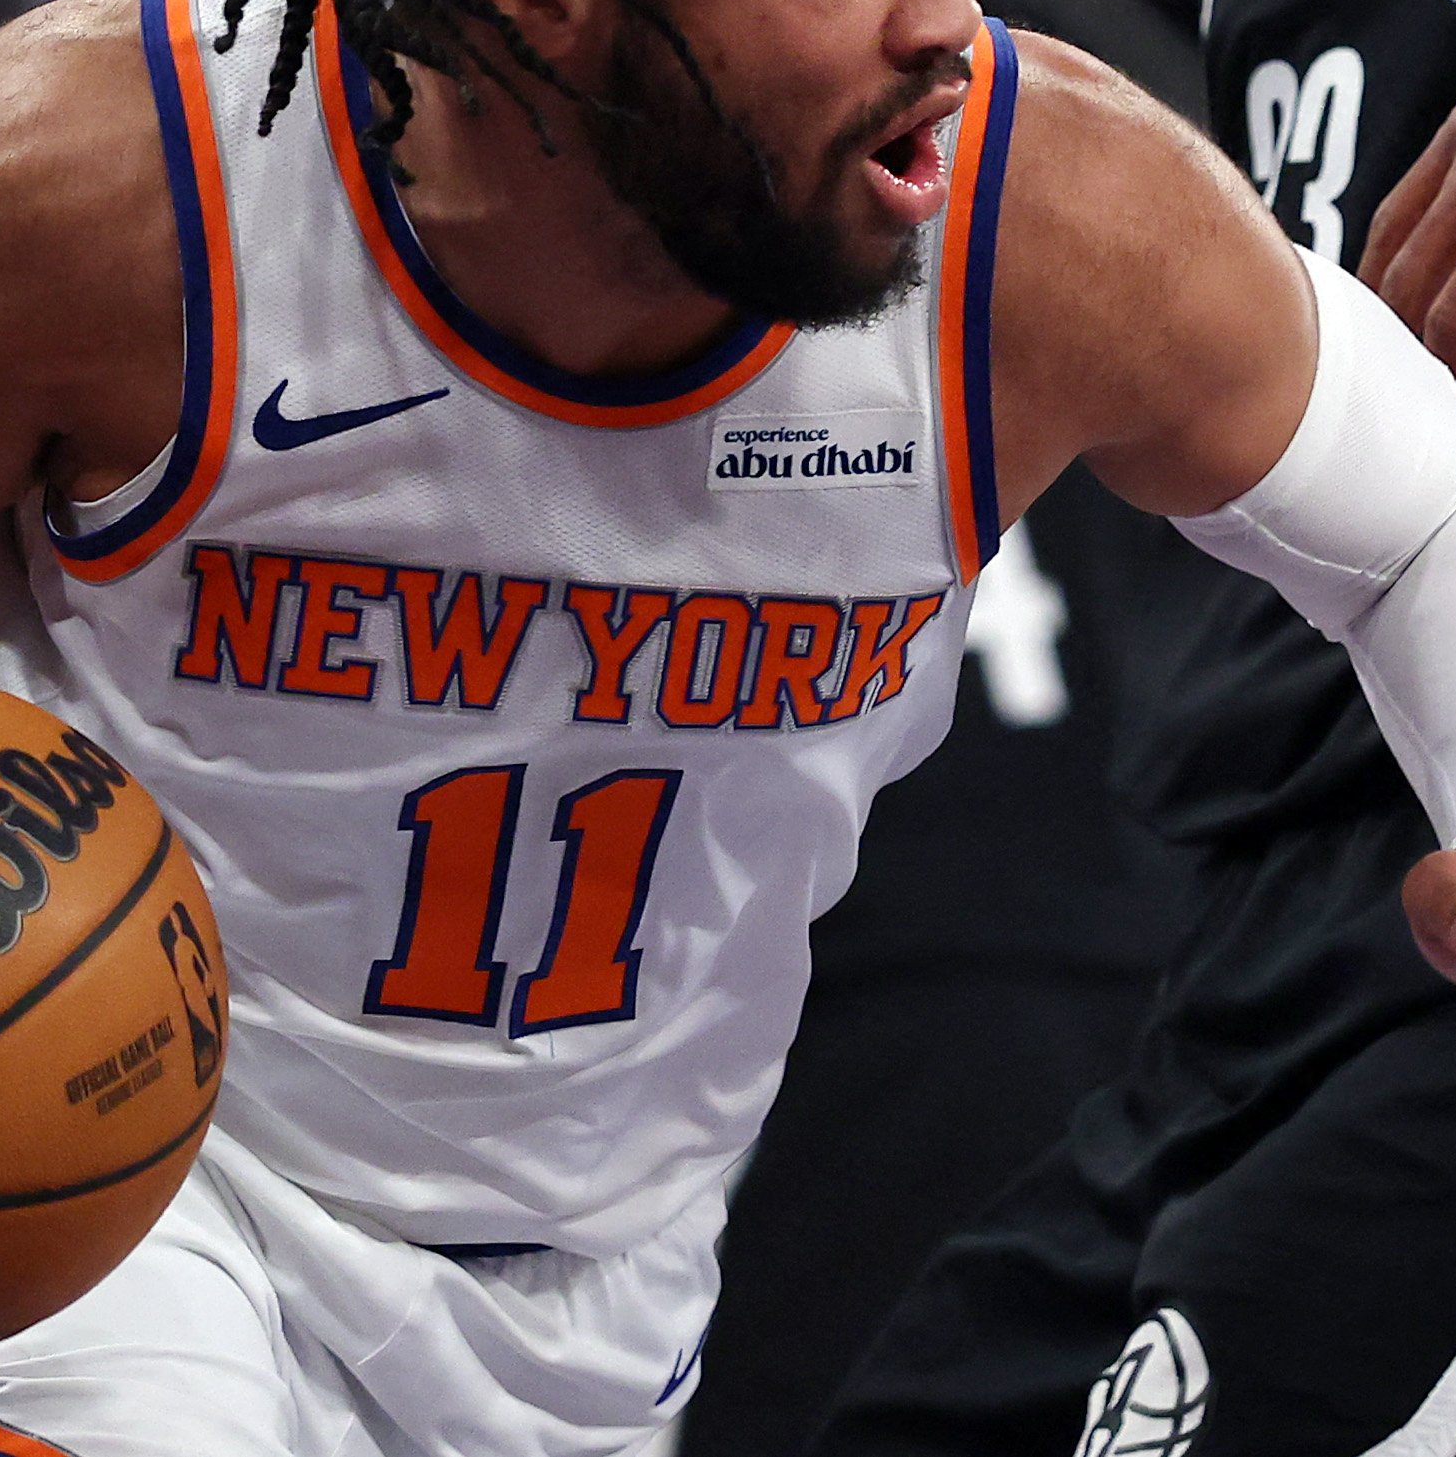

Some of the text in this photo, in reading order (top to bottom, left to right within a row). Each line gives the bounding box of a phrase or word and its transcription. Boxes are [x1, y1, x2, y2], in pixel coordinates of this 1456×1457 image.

[716, 446, 793, 478] abu
[724, 427, 829, 445] experience
[175, 546, 945, 730] NEW YORK
[362, 763, 685, 1040] 11
